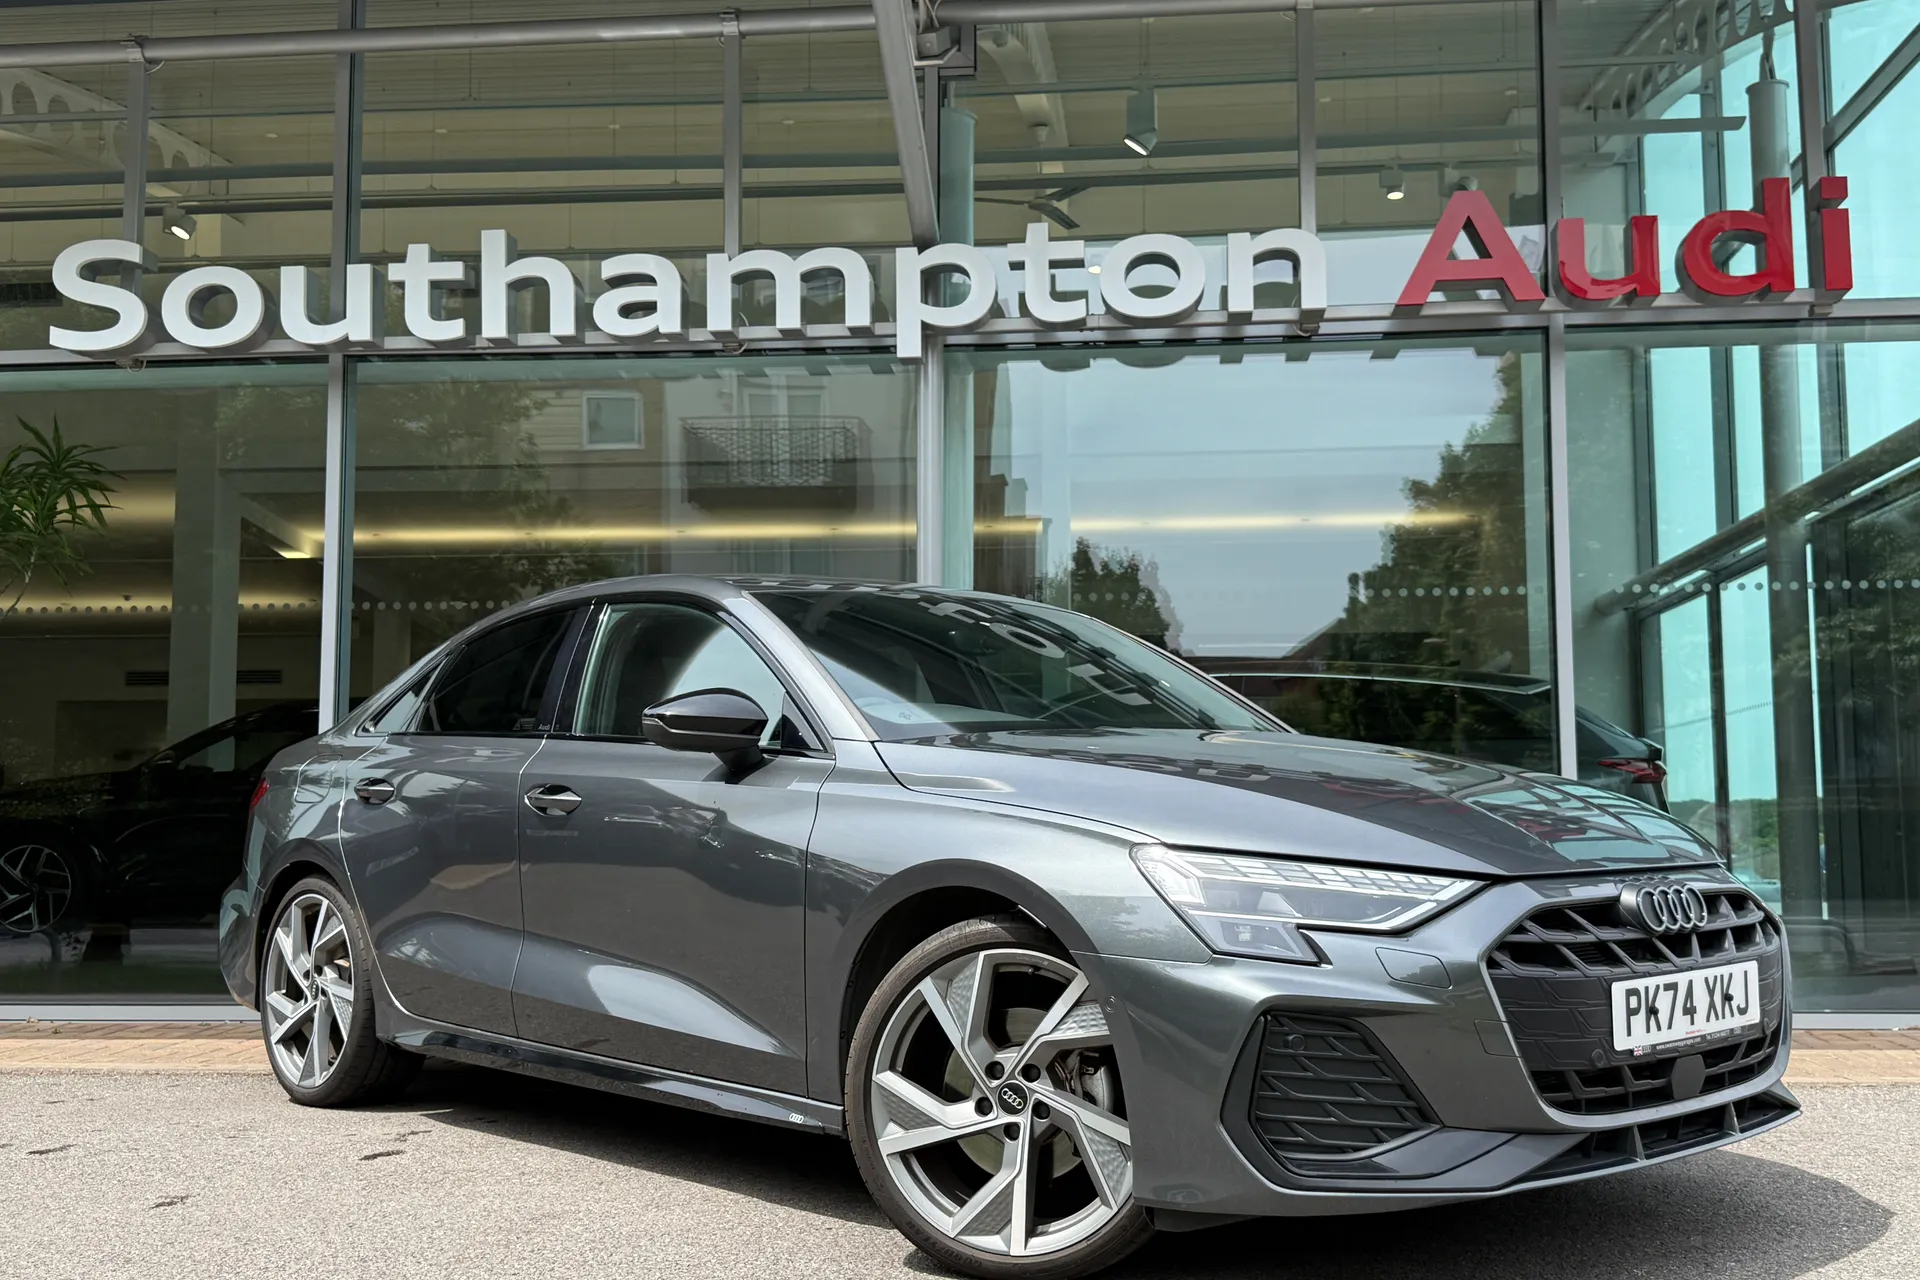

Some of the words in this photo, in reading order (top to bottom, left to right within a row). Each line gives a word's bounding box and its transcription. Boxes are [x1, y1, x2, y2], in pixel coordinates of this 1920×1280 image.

[49, 223, 1328, 358] Southampton
[1396, 176, 1854, 306] Audi
[1625, 979, 1697, 1037] PK74
[1704, 970, 1749, 1023] XKJ
